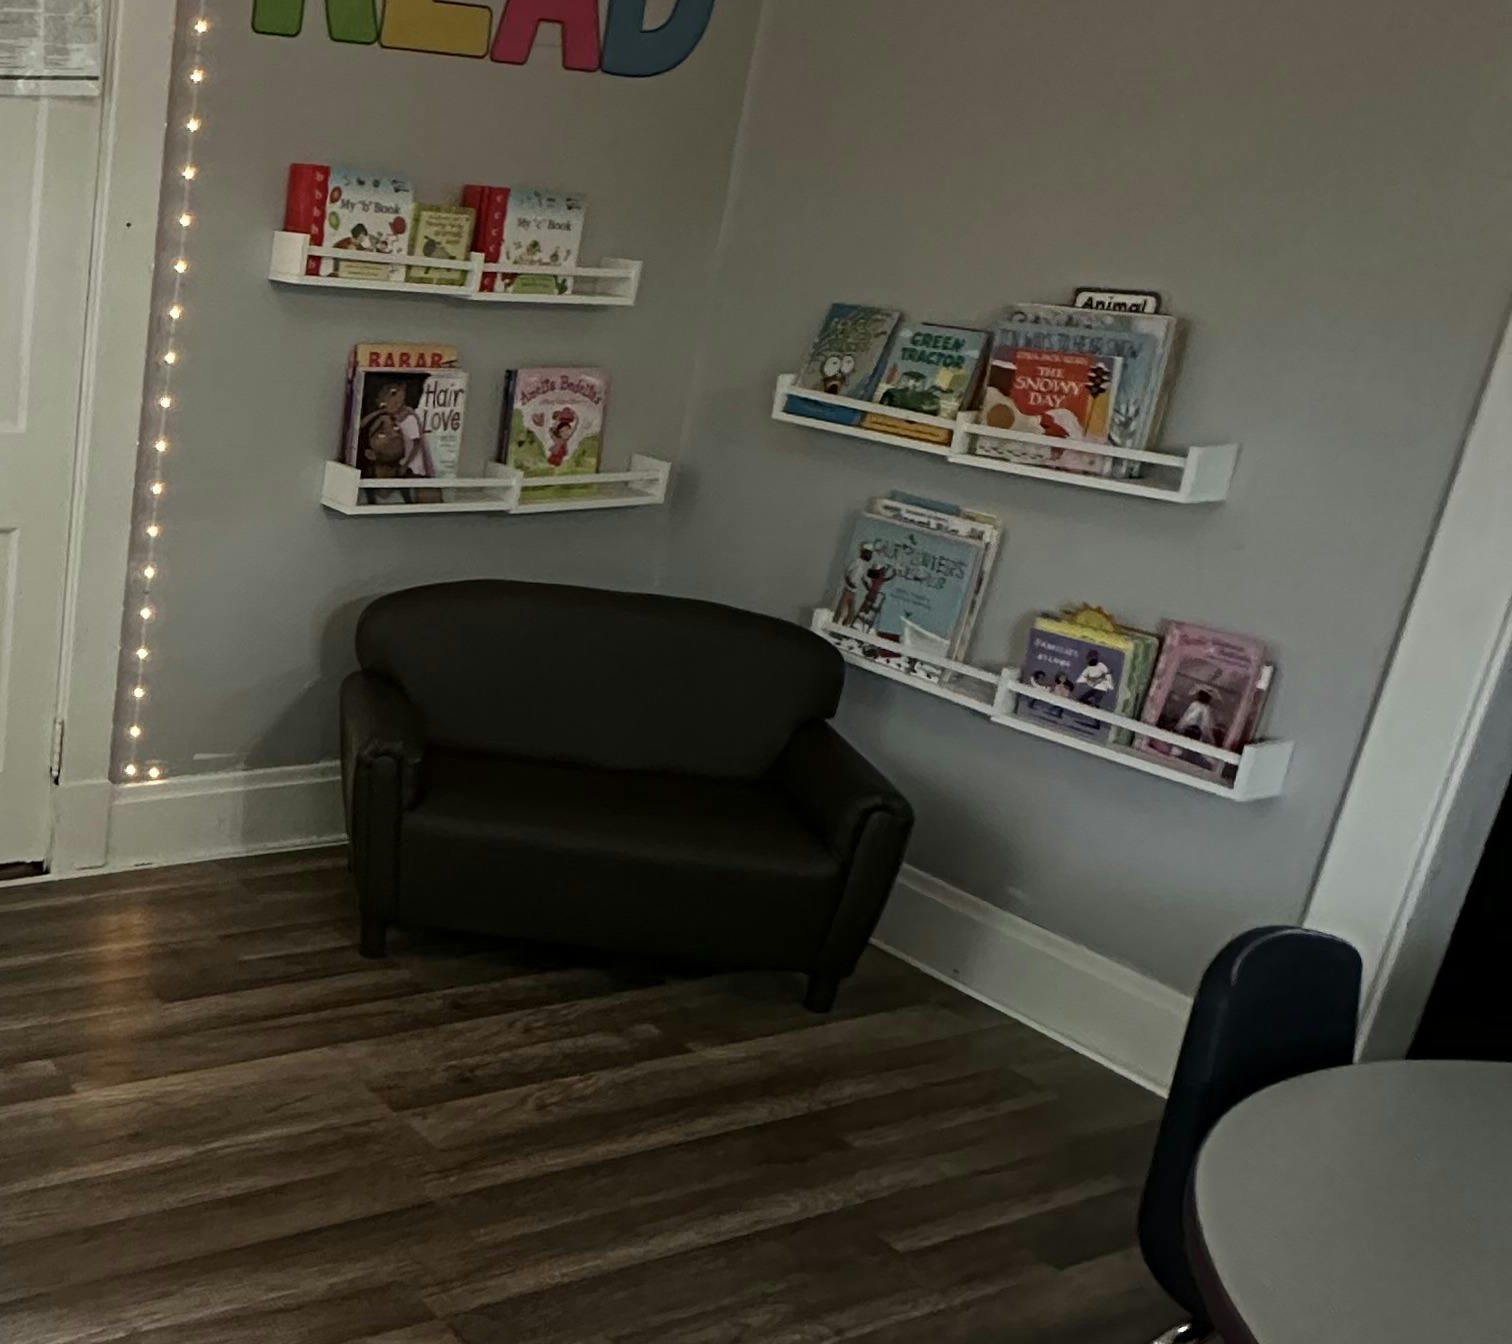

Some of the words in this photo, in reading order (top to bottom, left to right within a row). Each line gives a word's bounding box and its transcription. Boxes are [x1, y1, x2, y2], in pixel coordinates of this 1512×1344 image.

[1081, 297, 1148, 314] Animal
[910, 331, 967, 353] GREEN
[901, 346, 965, 369] TRACTOR
[1039, 366, 1065, 379] THE
[425, 381, 465, 408] Hair
[1014, 375, 1083, 397] SNOWY
[1029, 392, 1065, 410] DAY
